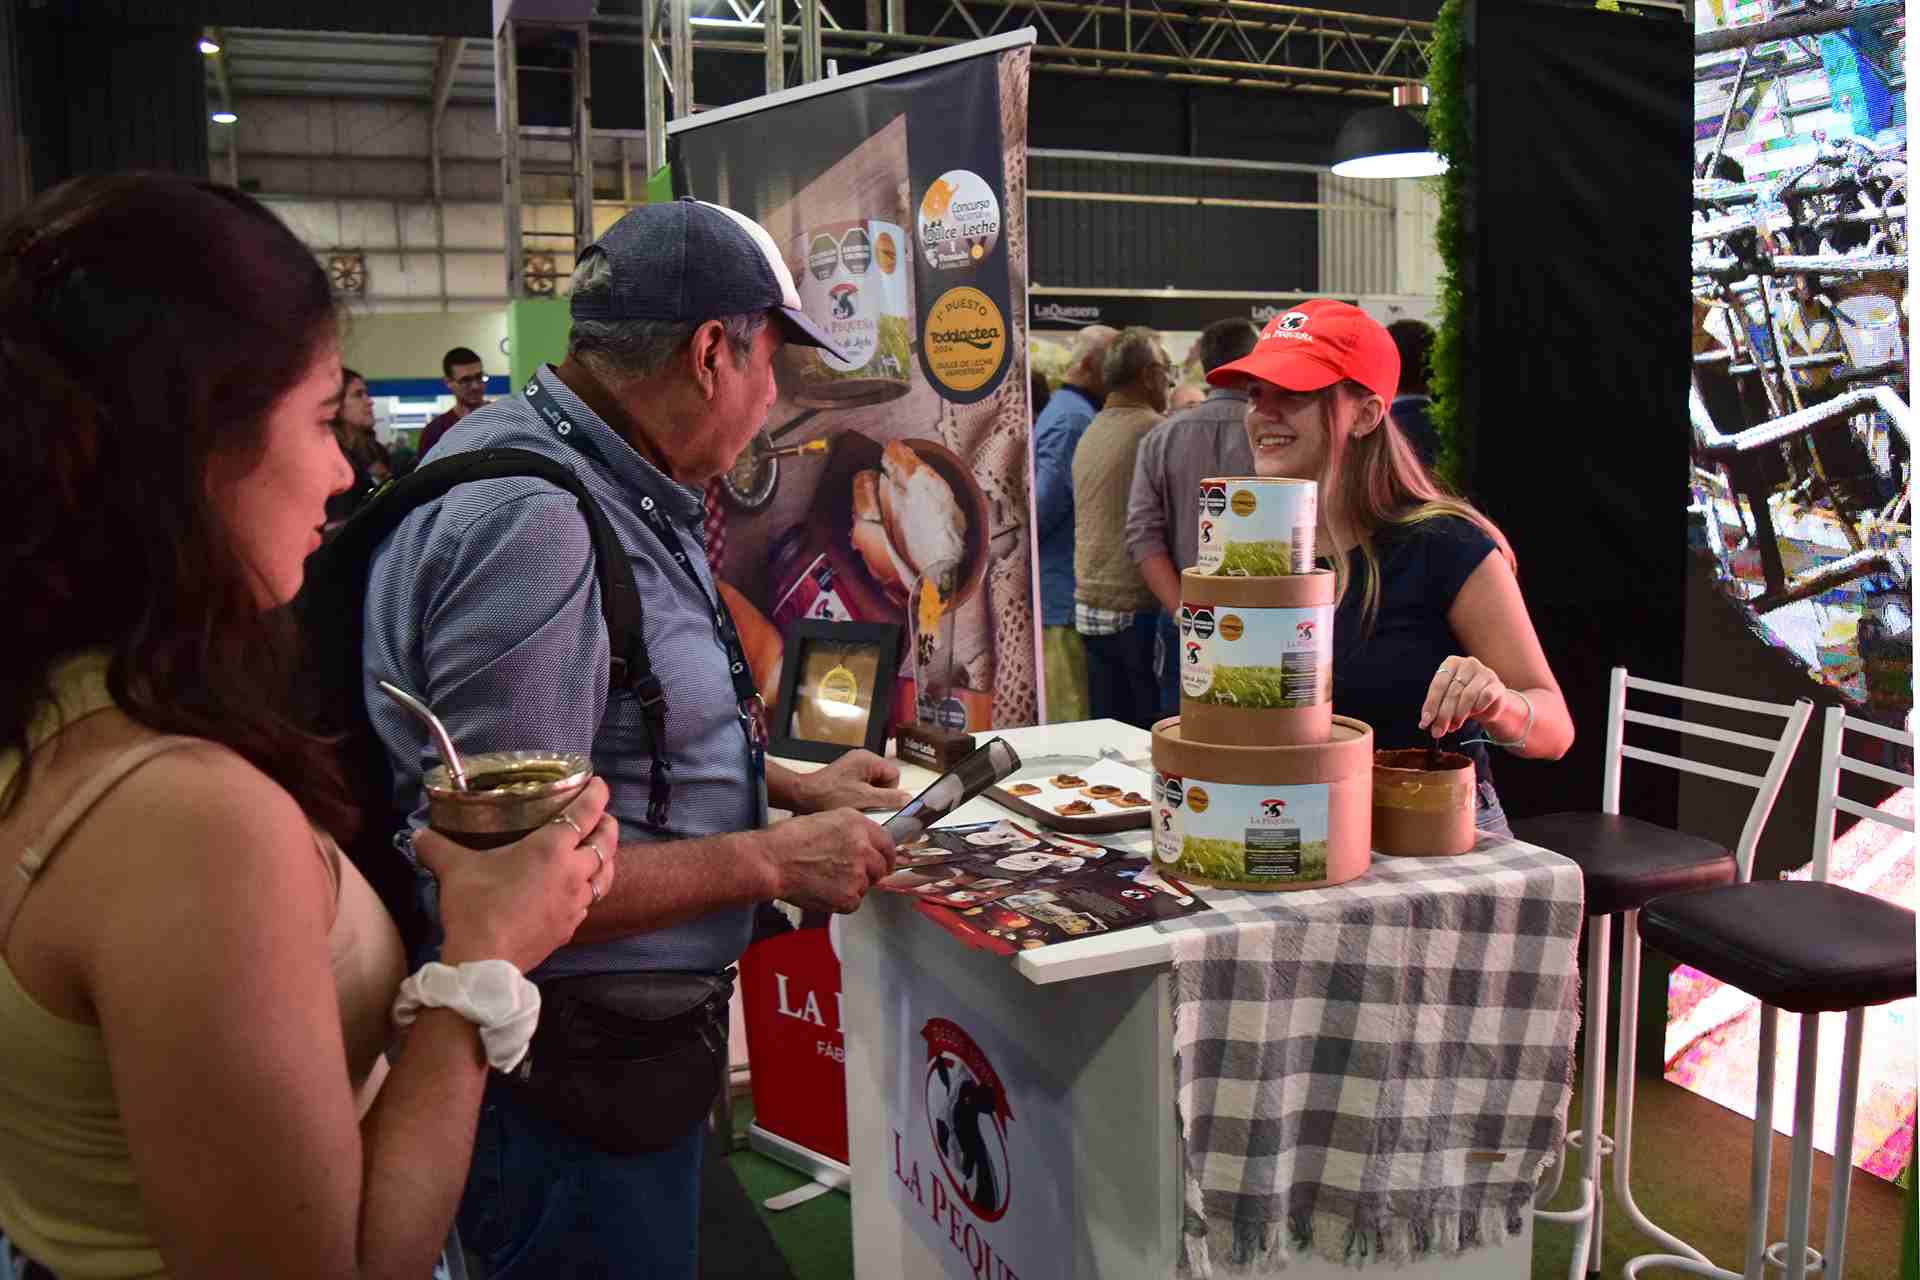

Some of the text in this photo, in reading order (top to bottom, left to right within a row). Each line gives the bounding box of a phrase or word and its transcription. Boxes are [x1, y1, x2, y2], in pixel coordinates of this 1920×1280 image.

[951, 200, 990, 214] Concurso
[962, 219, 997, 237] Leche
[945, 298, 988, 317] PUESTO
[1034, 303, 1100, 318] LaQuesera
[775, 972, 827, 1027] LA
[892, 1127, 925, 1208] LA
